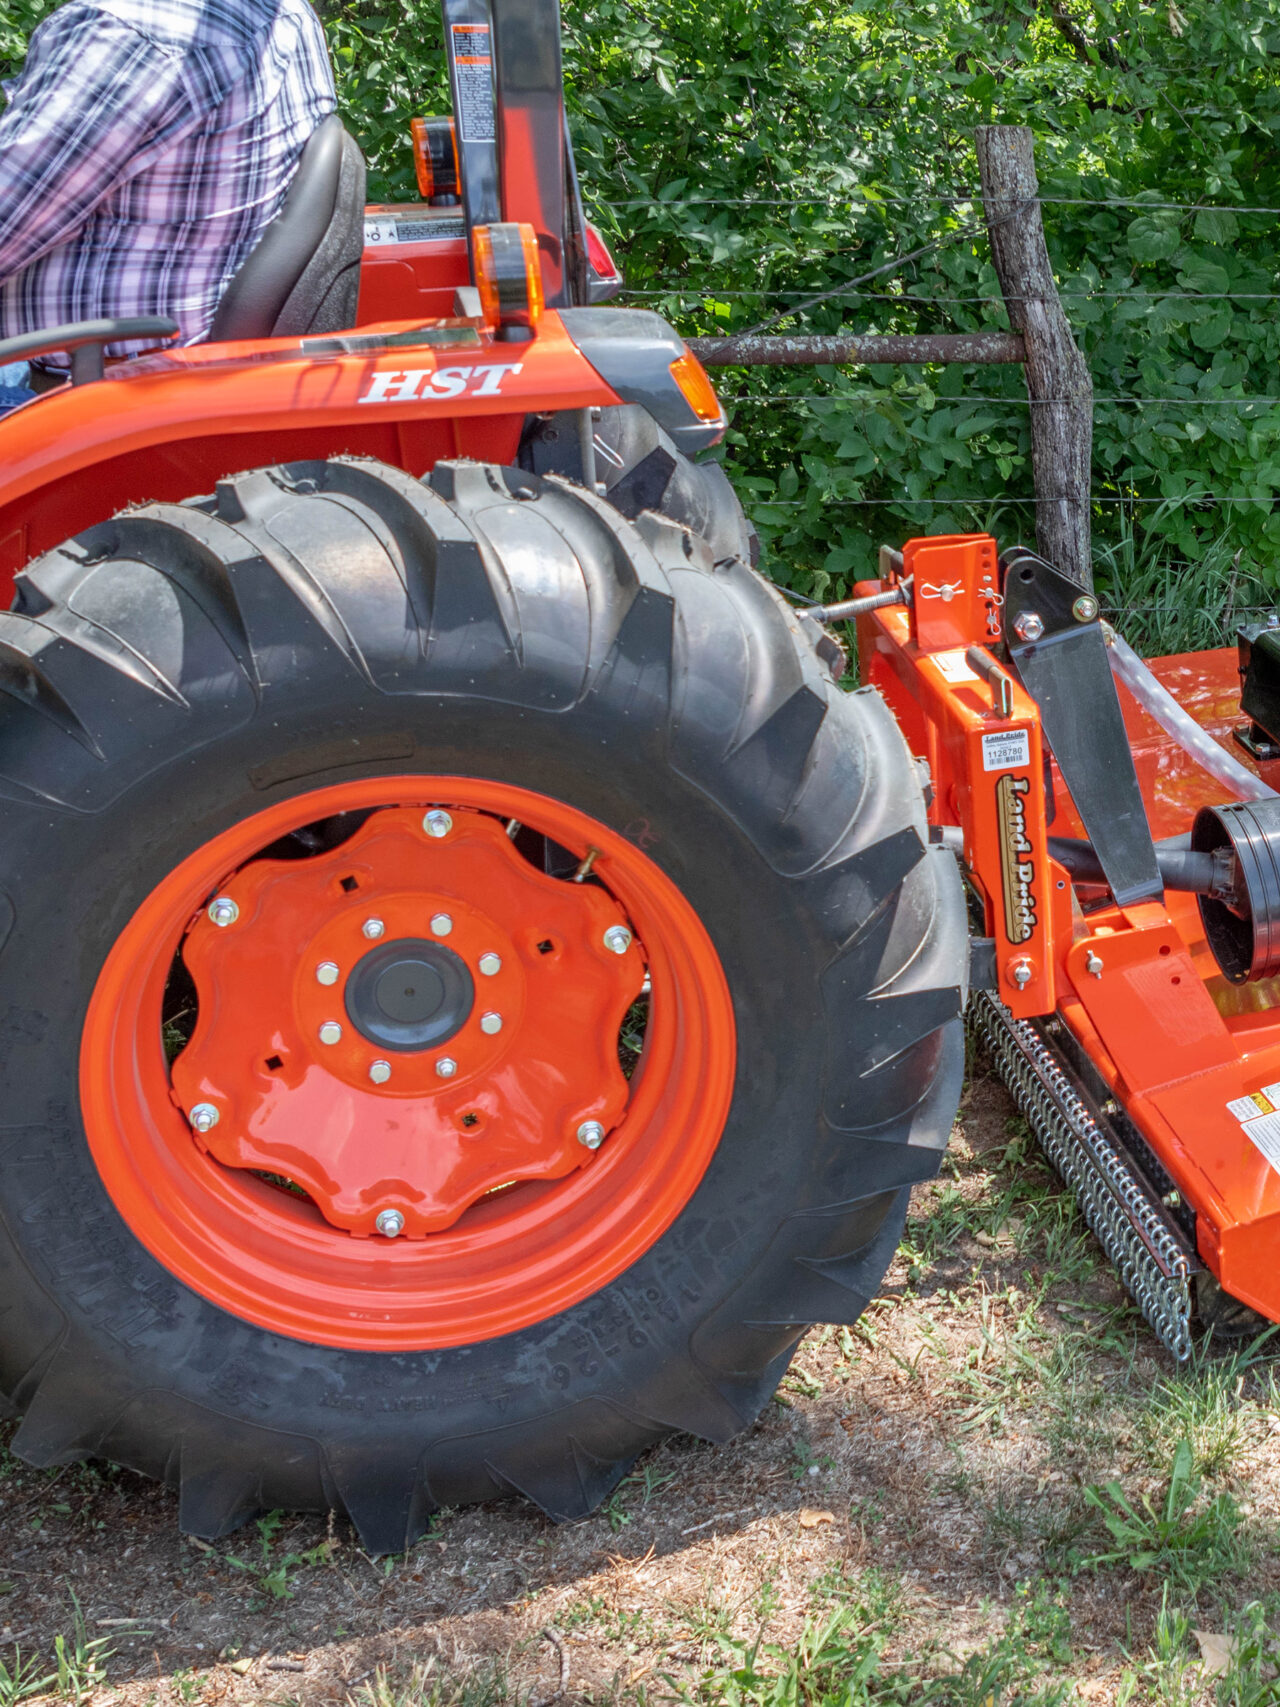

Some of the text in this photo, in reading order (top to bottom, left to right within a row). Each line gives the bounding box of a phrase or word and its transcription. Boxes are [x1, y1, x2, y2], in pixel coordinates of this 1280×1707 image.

[358, 363, 523, 403] HST
[988, 747, 1022, 758] 1128780
[1006, 777, 1037, 940] Land Pride
